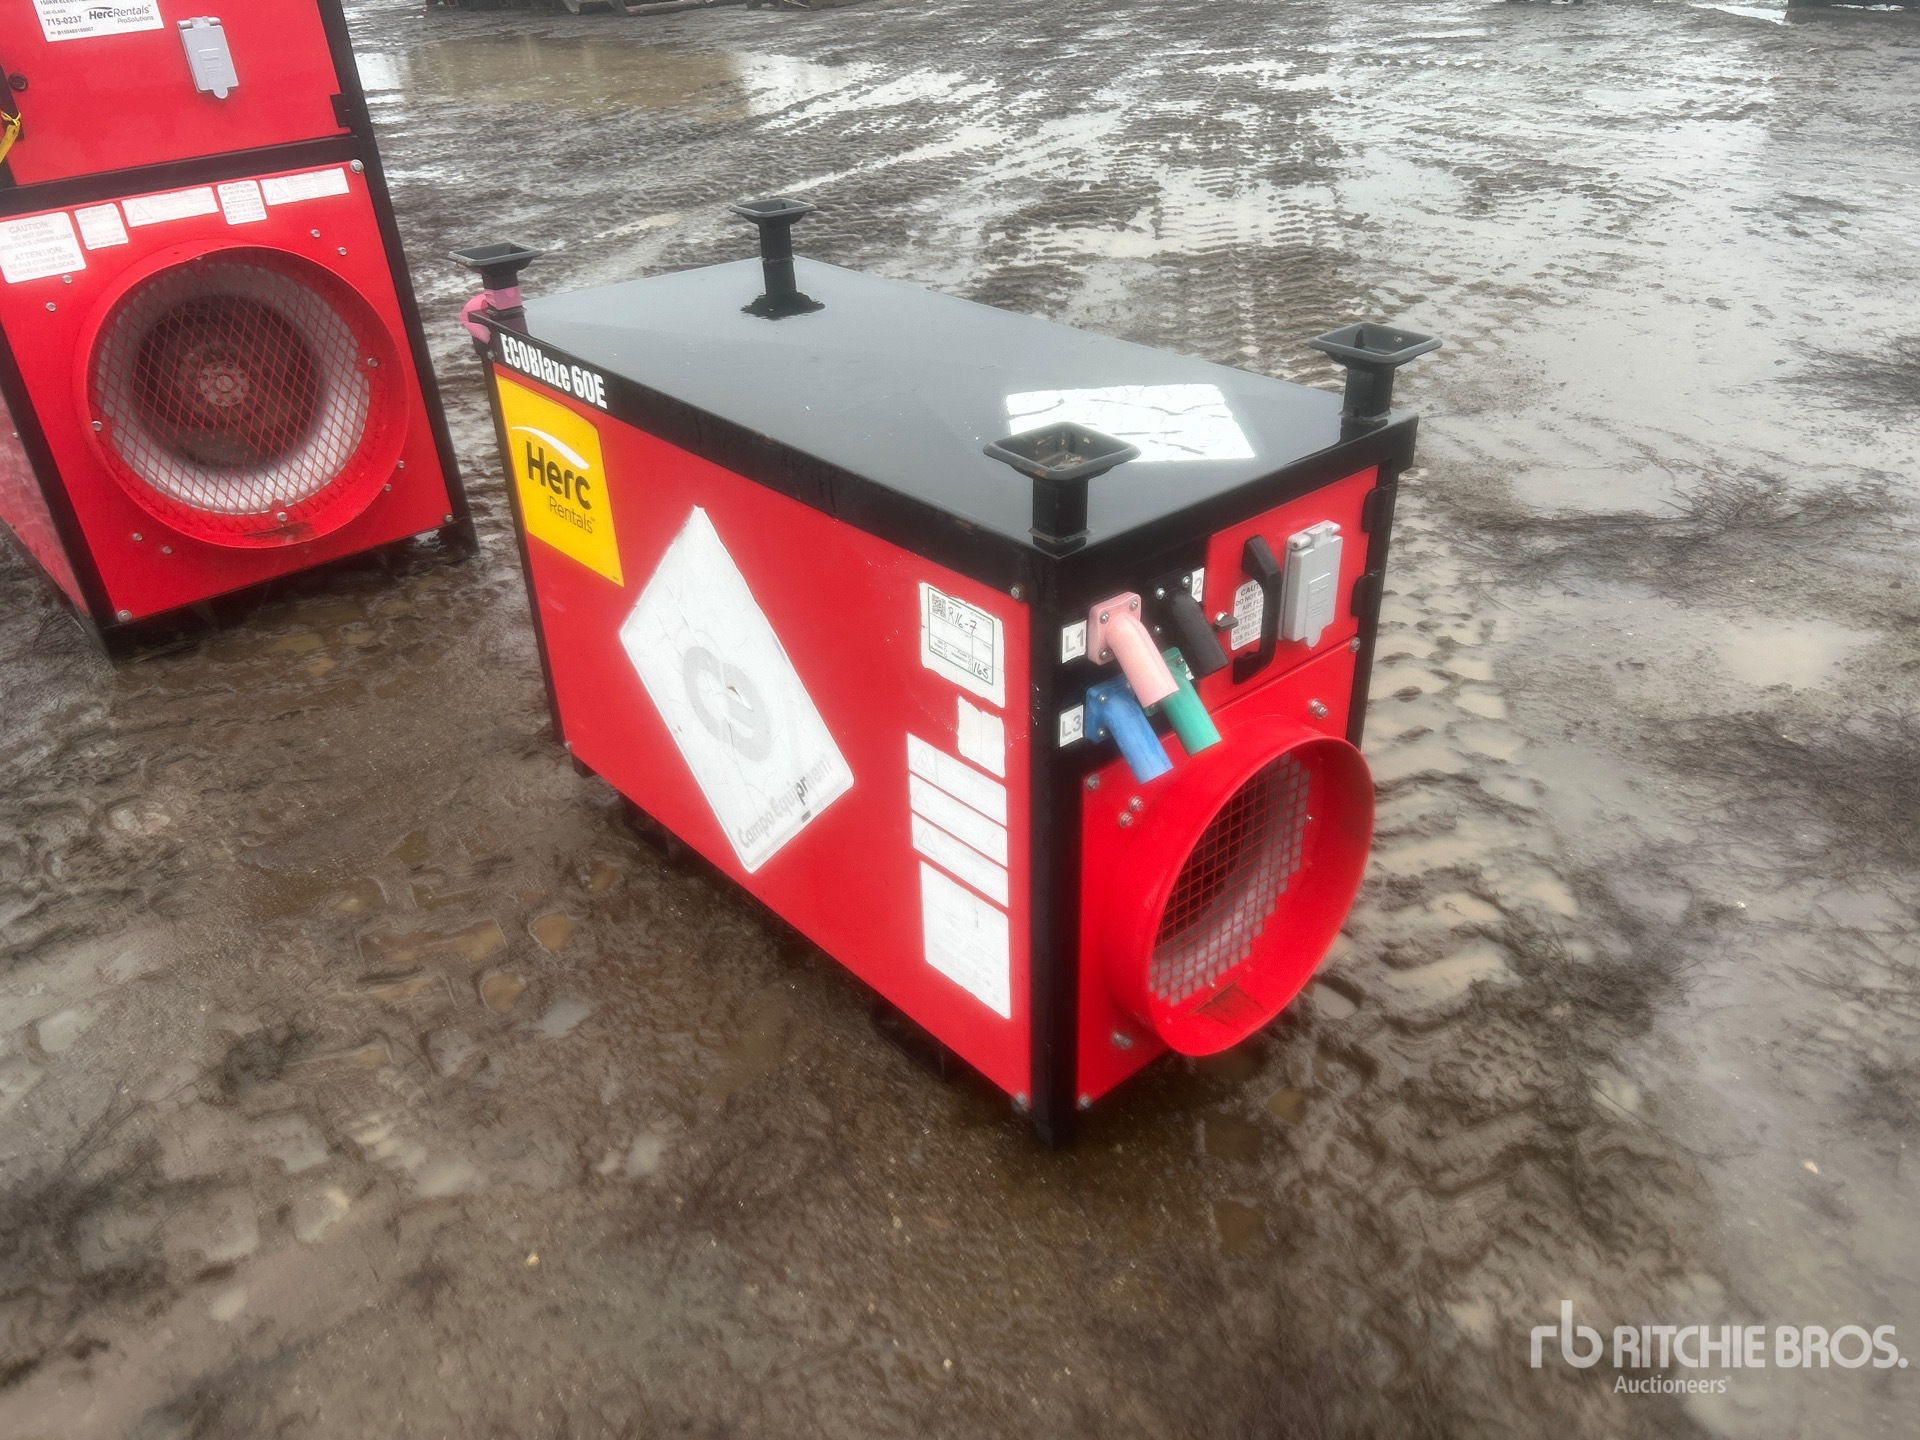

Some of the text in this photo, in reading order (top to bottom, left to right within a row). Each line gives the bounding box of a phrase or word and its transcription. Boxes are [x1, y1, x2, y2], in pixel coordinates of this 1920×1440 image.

[45, 15, 82, 26] 715-0237
[117, 15, 154, 24] ProSolutions
[499, 332, 608, 410] ECOBlaze 60E
[526, 440, 592, 511] Herc
[548, 495, 594, 535] Rentals
[1235, 599, 1244, 607] DO
[1244, 592, 1257, 602] NOT
[1241, 602, 1253, 611] AIR
[1065, 629, 1085, 654] L1
[1061, 714, 1082, 737] L3
[737, 809, 776, 849] Campo
